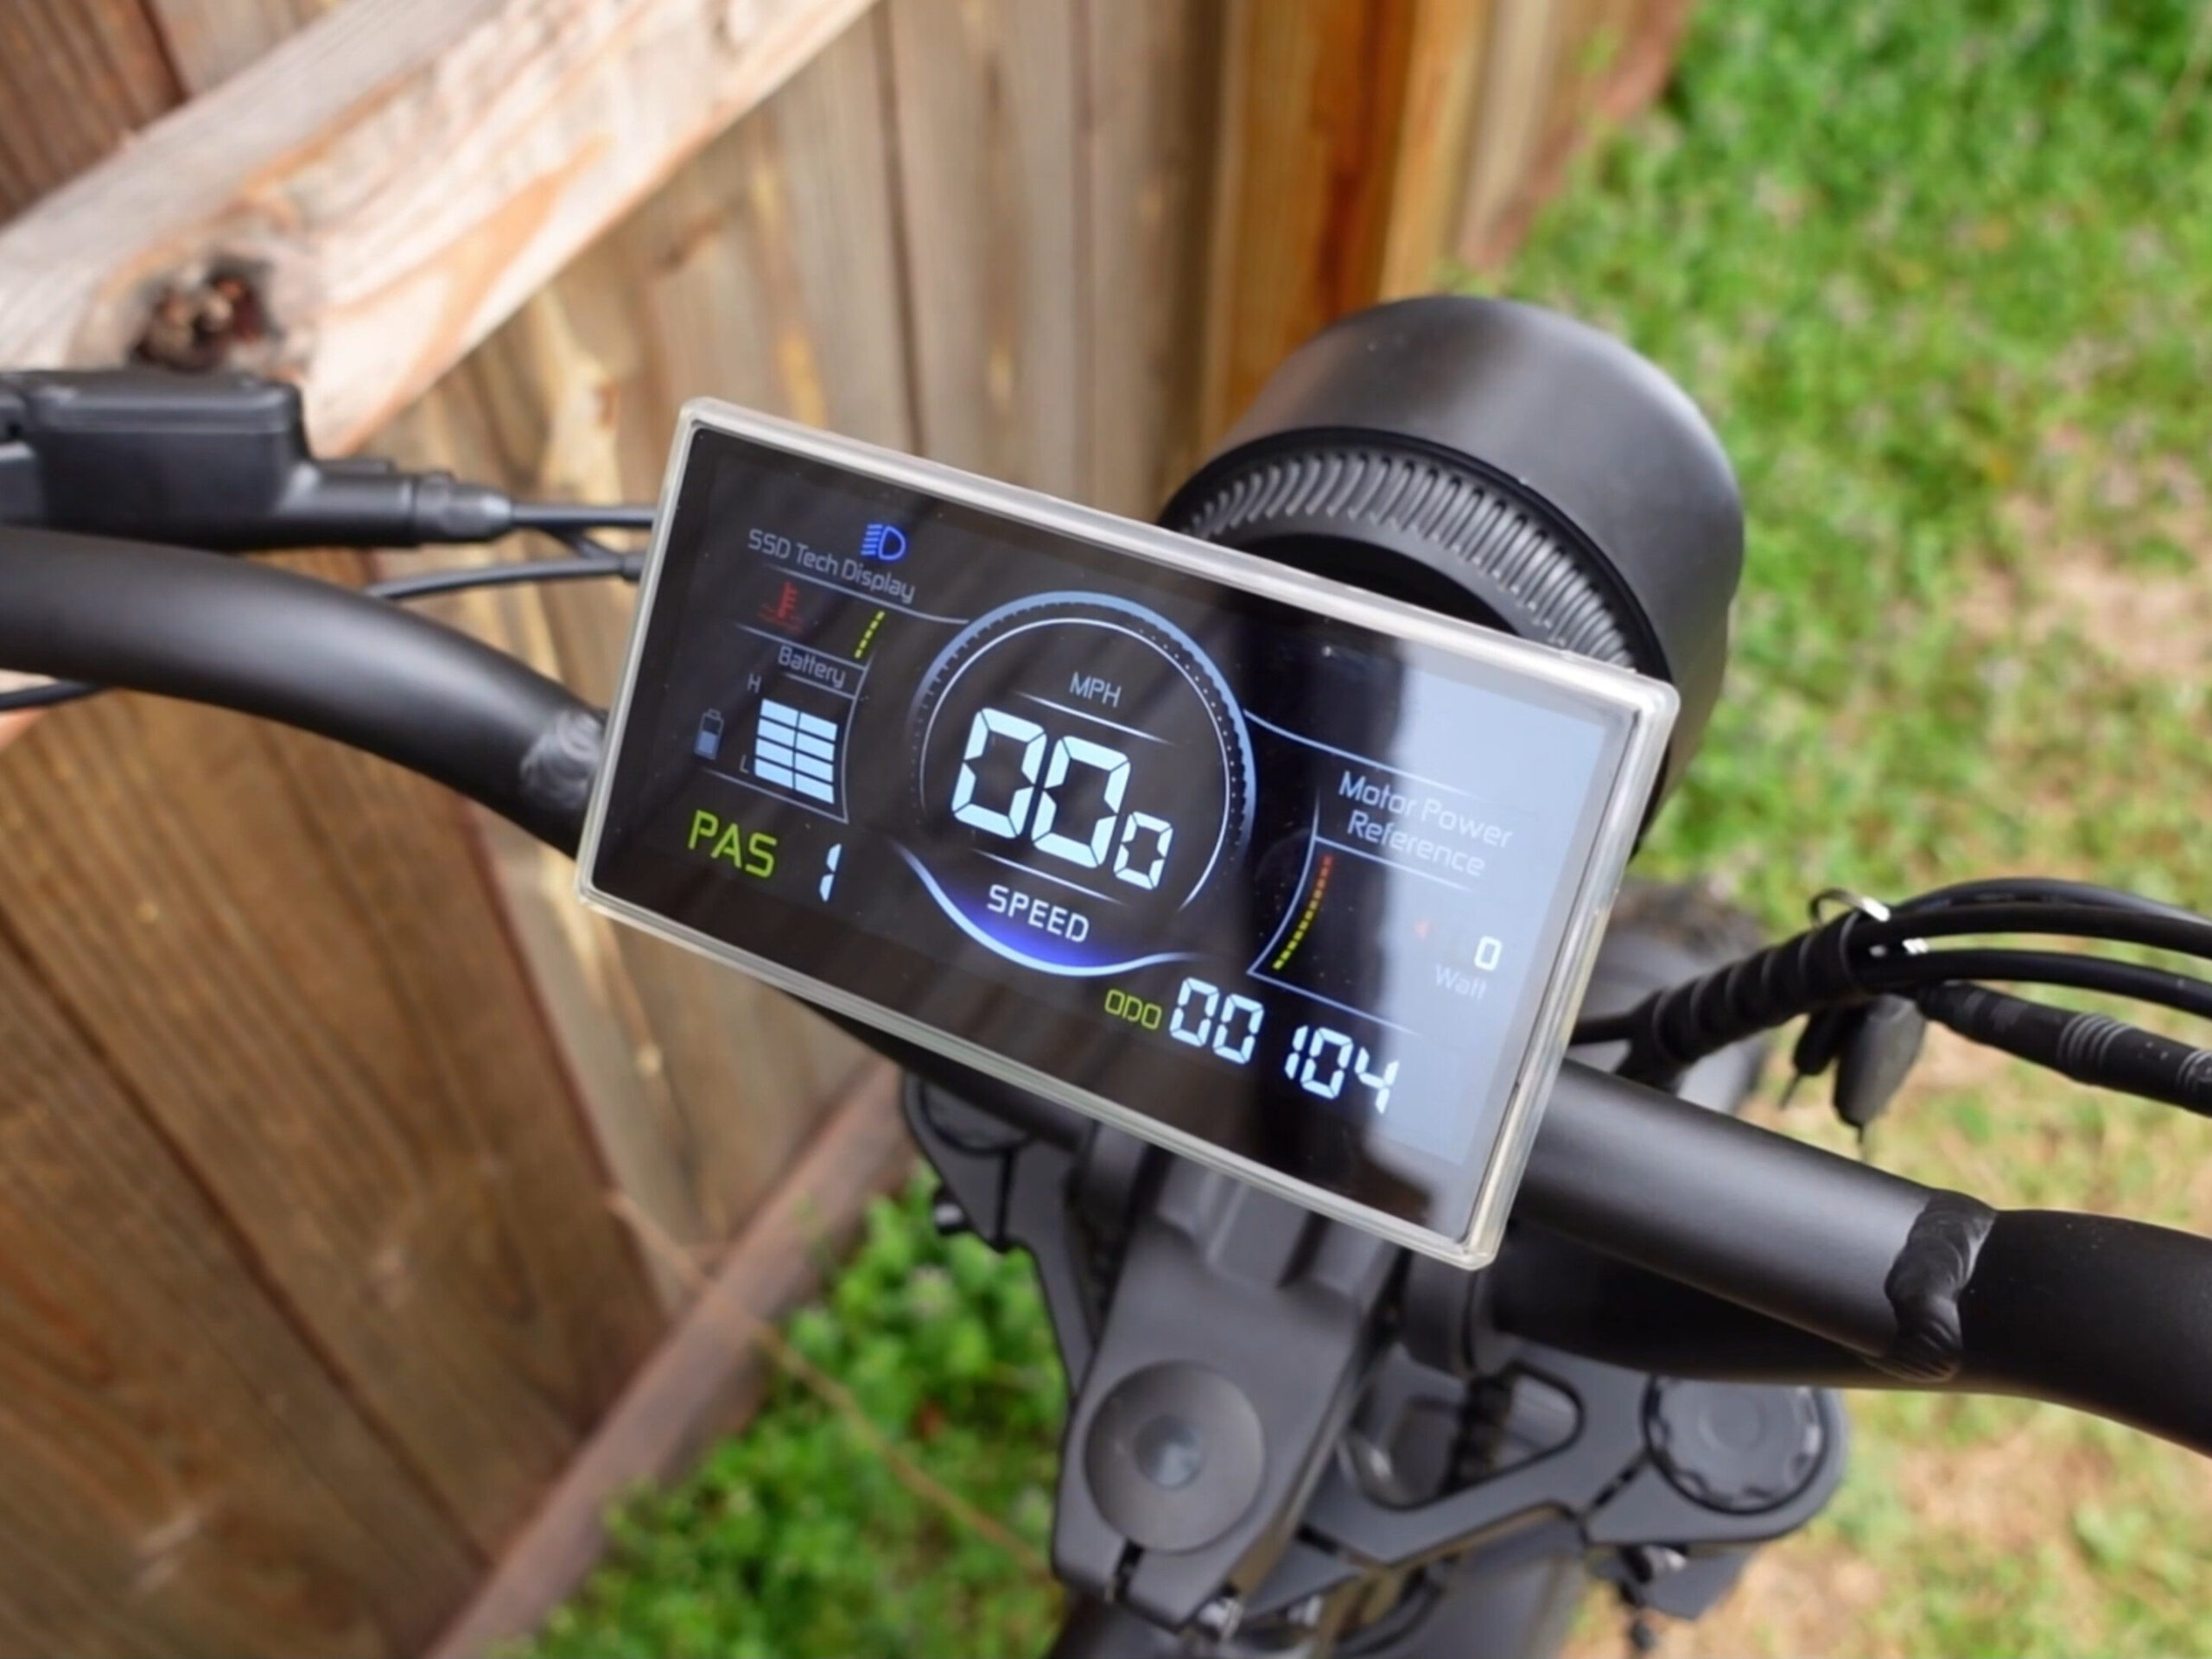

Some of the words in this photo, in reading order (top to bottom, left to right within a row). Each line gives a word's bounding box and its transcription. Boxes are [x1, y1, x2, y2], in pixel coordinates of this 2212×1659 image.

[747, 529, 791, 559] SSD
[796, 543, 838, 575] Tech
[842, 559, 915, 604] Display
[747, 673, 762, 694] H
[778, 645, 846, 688] Battery
[1070, 672, 1122, 708] MPH
[740, 755, 749, 774] L
[1338, 771, 1416, 818] Motor
[1421, 798, 1513, 849] Power
[688, 810, 778, 878] PAS
[819, 843, 842, 902] 1
[1348, 810, 1485, 877] Reference
[987, 884, 1089, 942] SPEED
[1474, 936, 1502, 971] 0
[1435, 964, 1486, 1000] Watt
[1105, 989, 1162, 1030] ODO
